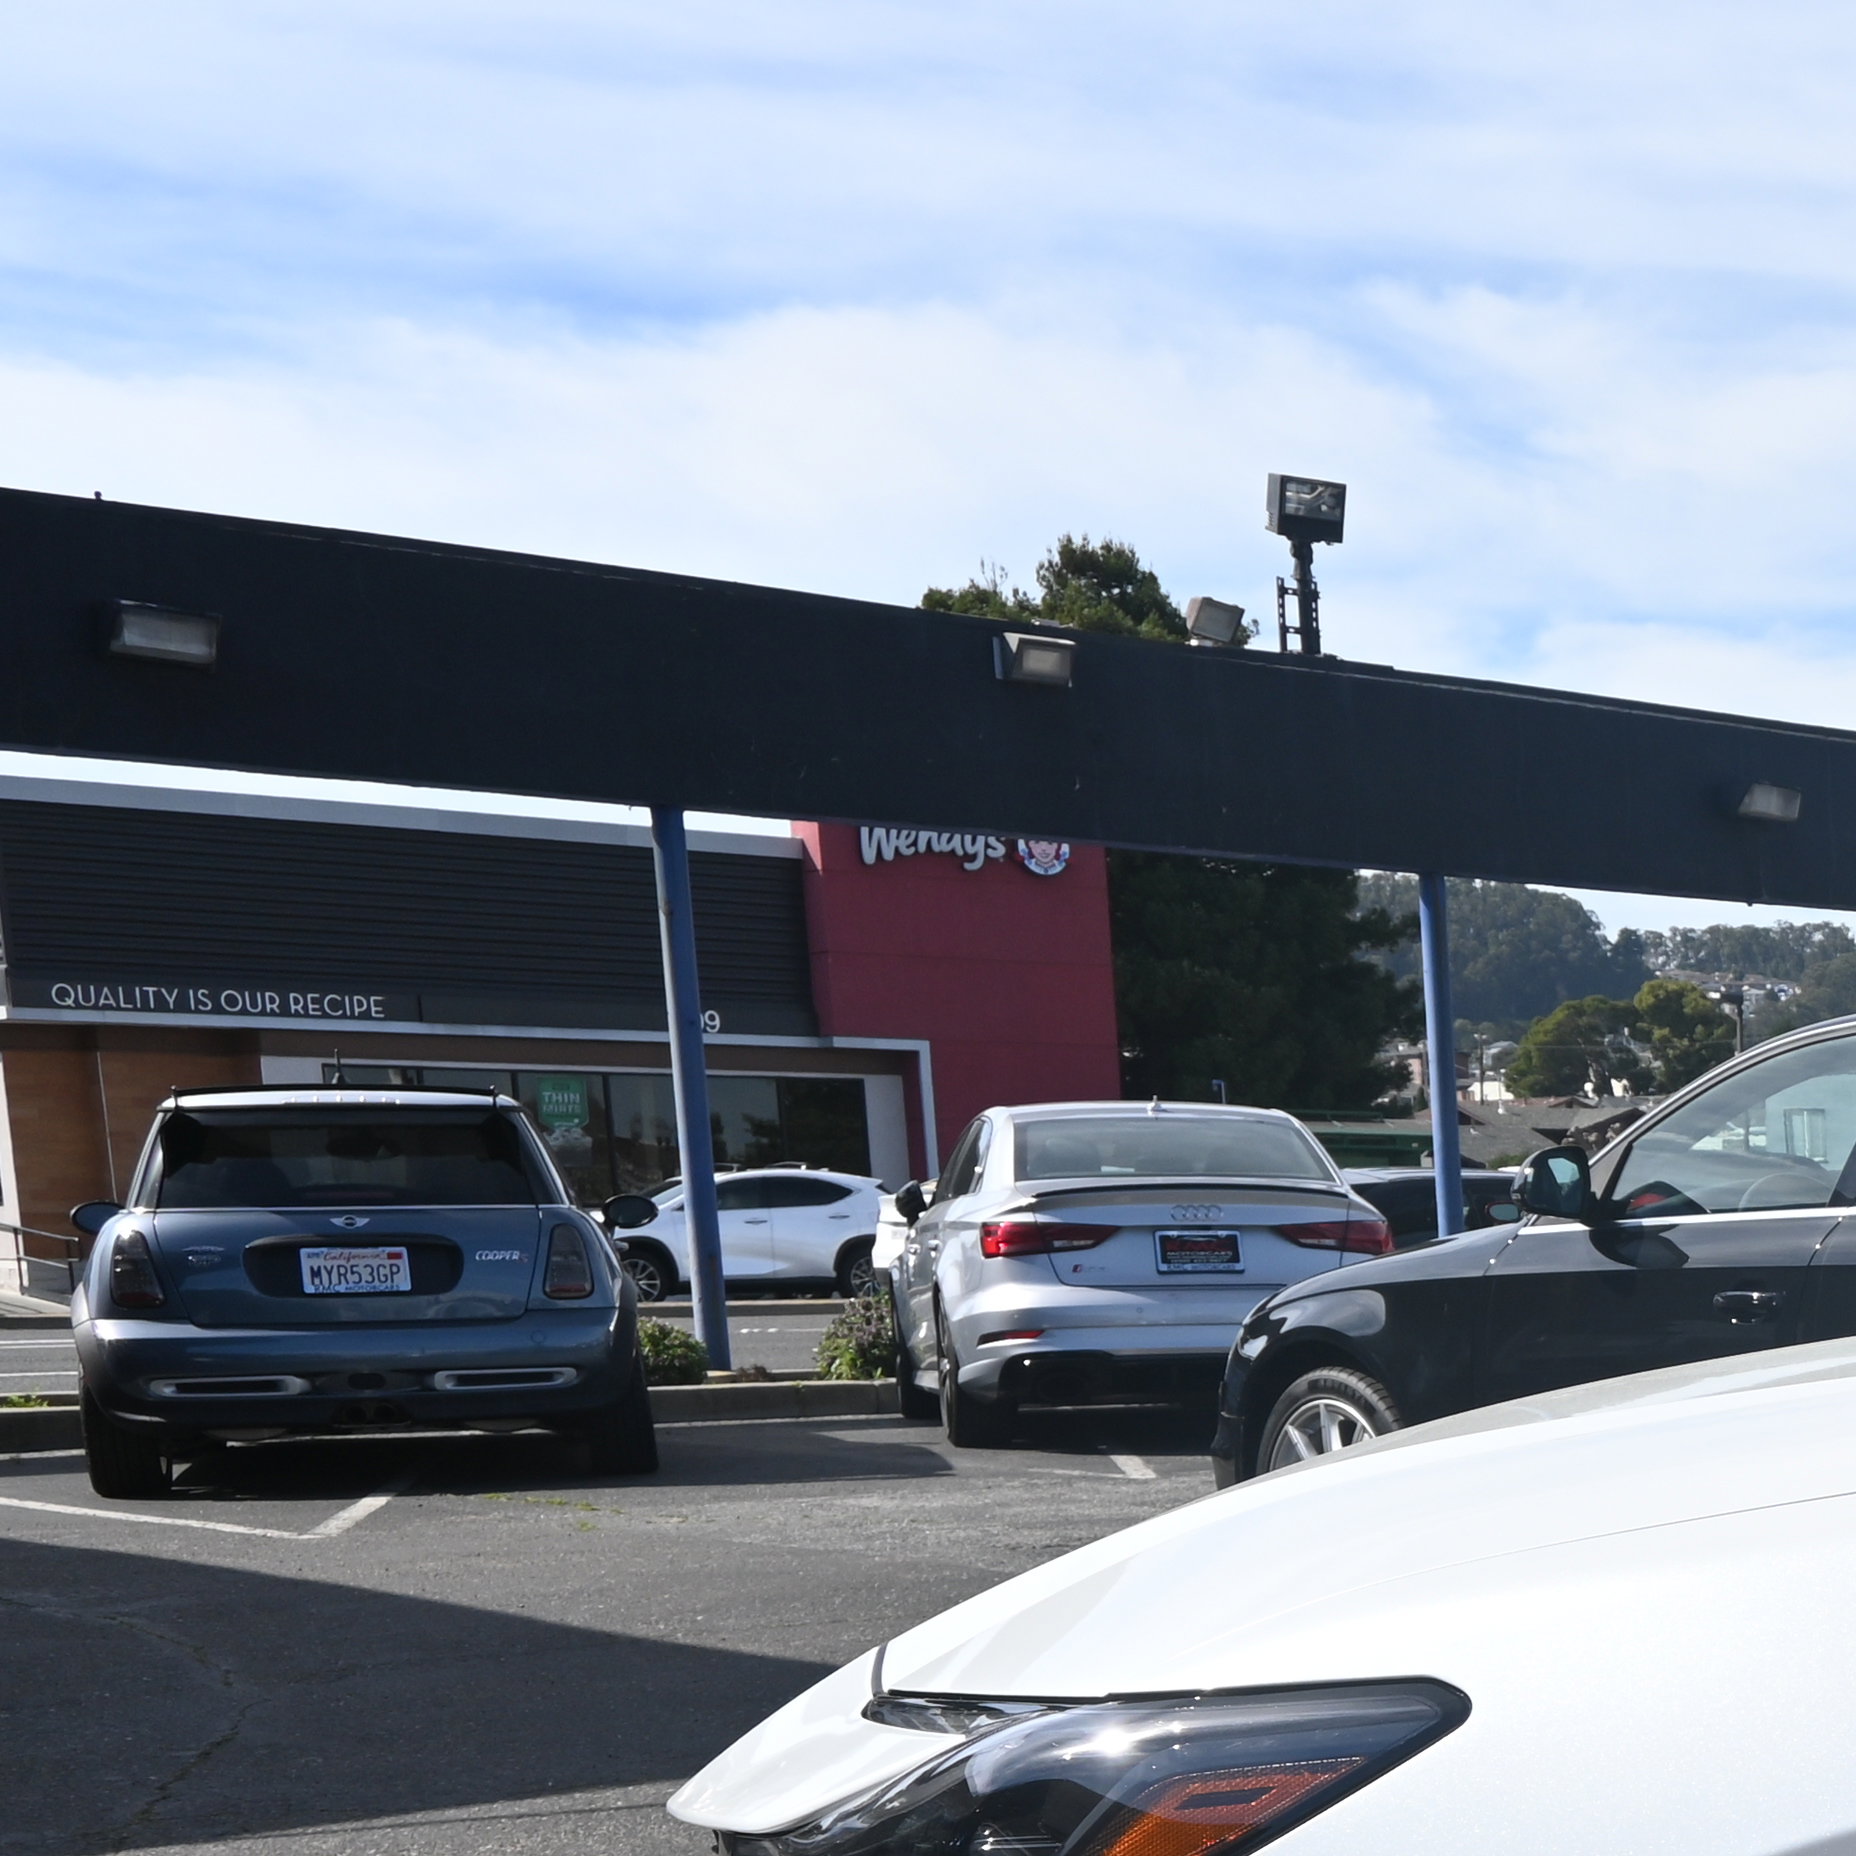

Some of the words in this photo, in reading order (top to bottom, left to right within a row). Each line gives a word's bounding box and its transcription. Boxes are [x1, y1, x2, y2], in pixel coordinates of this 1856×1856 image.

[51, 983, 178, 1010] QUALITY
[188, 988, 212, 1011] IS
[220, 990, 280, 1013] OUR
[289, 993, 385, 1018] RECIPE
[542, 1091, 580, 1103] THIN
[323, 1251, 382, 1264] California
[475, 1250, 520, 1261] COOPER
[310, 1263, 401, 1287] MYR53GP
